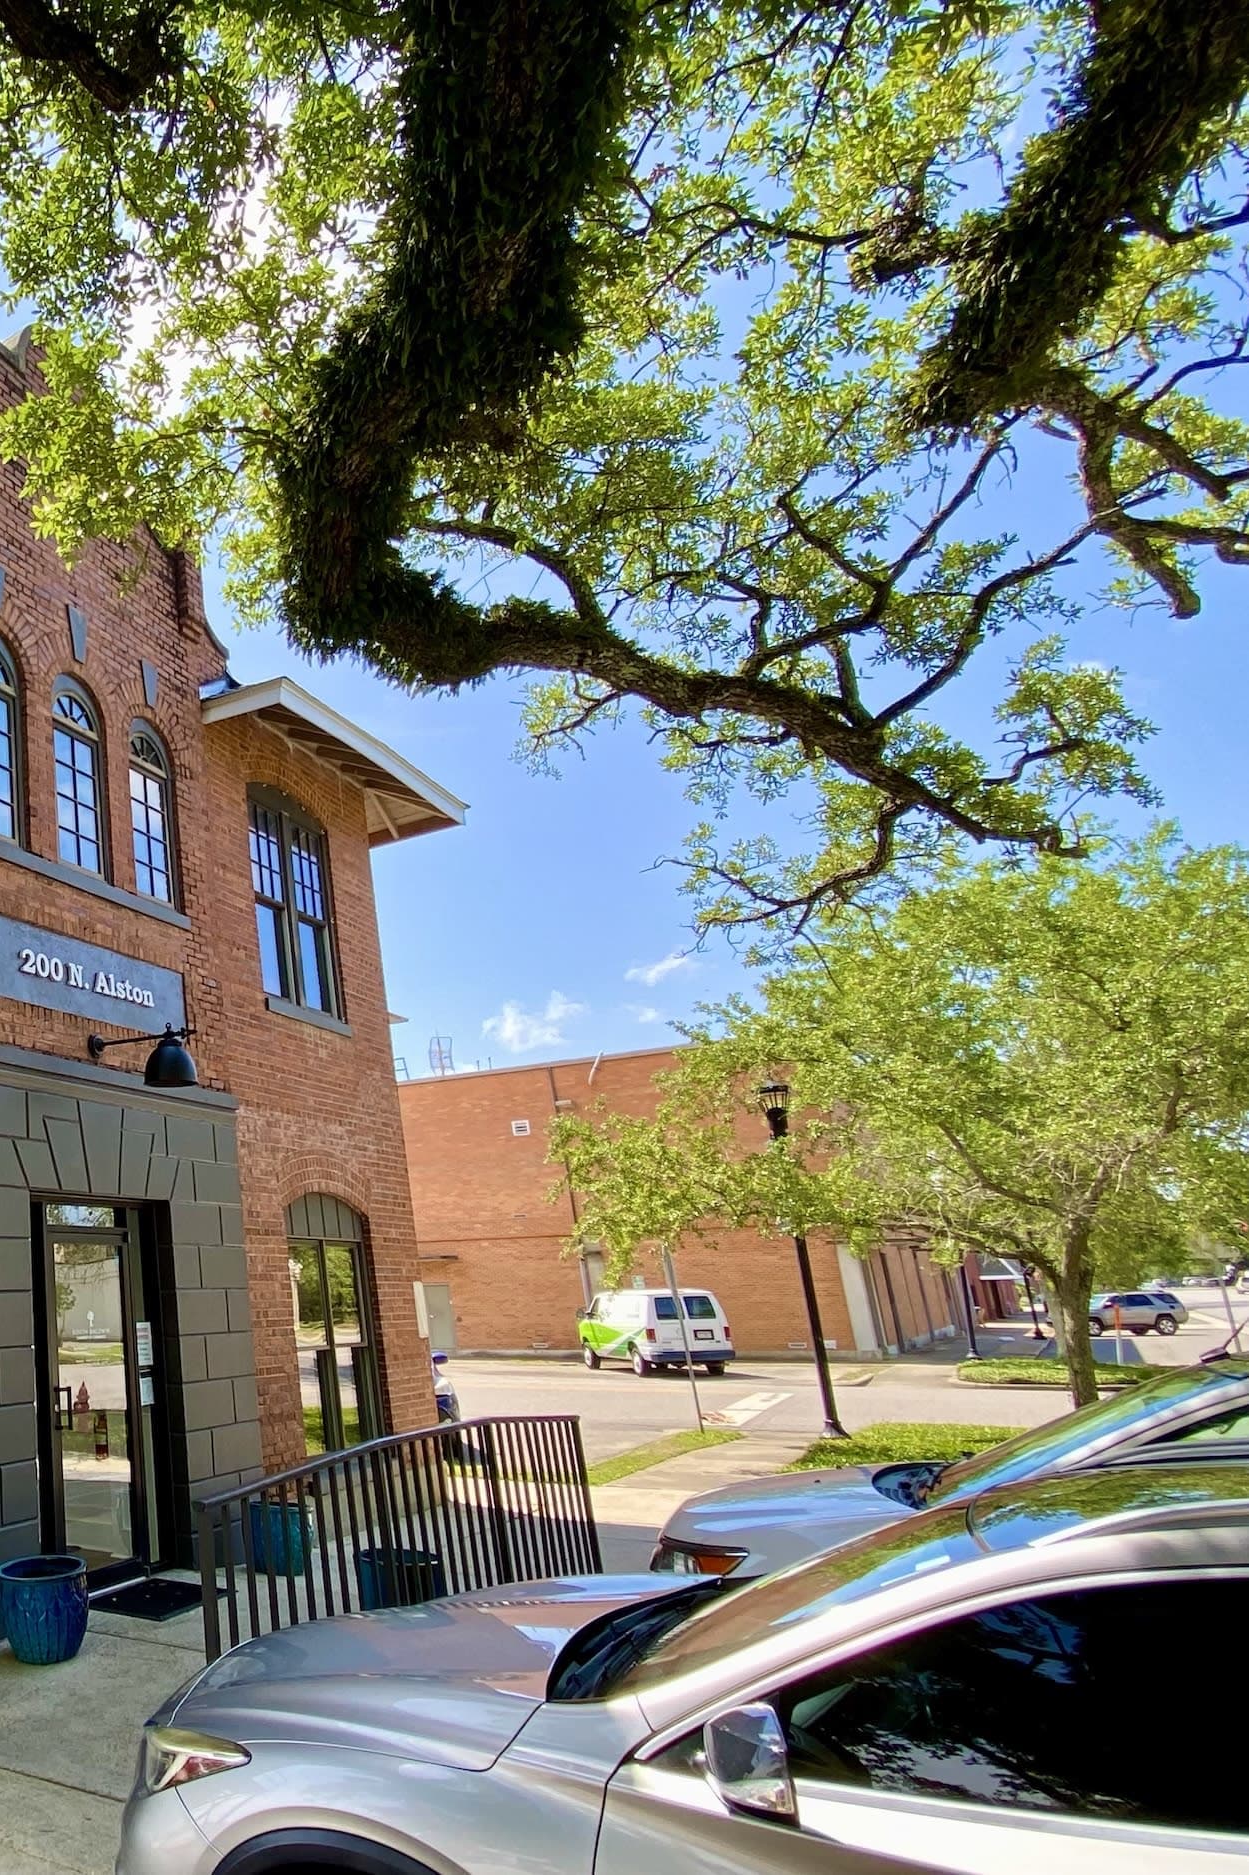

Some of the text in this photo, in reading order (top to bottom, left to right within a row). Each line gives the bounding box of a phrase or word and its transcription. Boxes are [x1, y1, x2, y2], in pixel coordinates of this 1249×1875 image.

[20, 948, 155, 1007] 200 N. Alston
